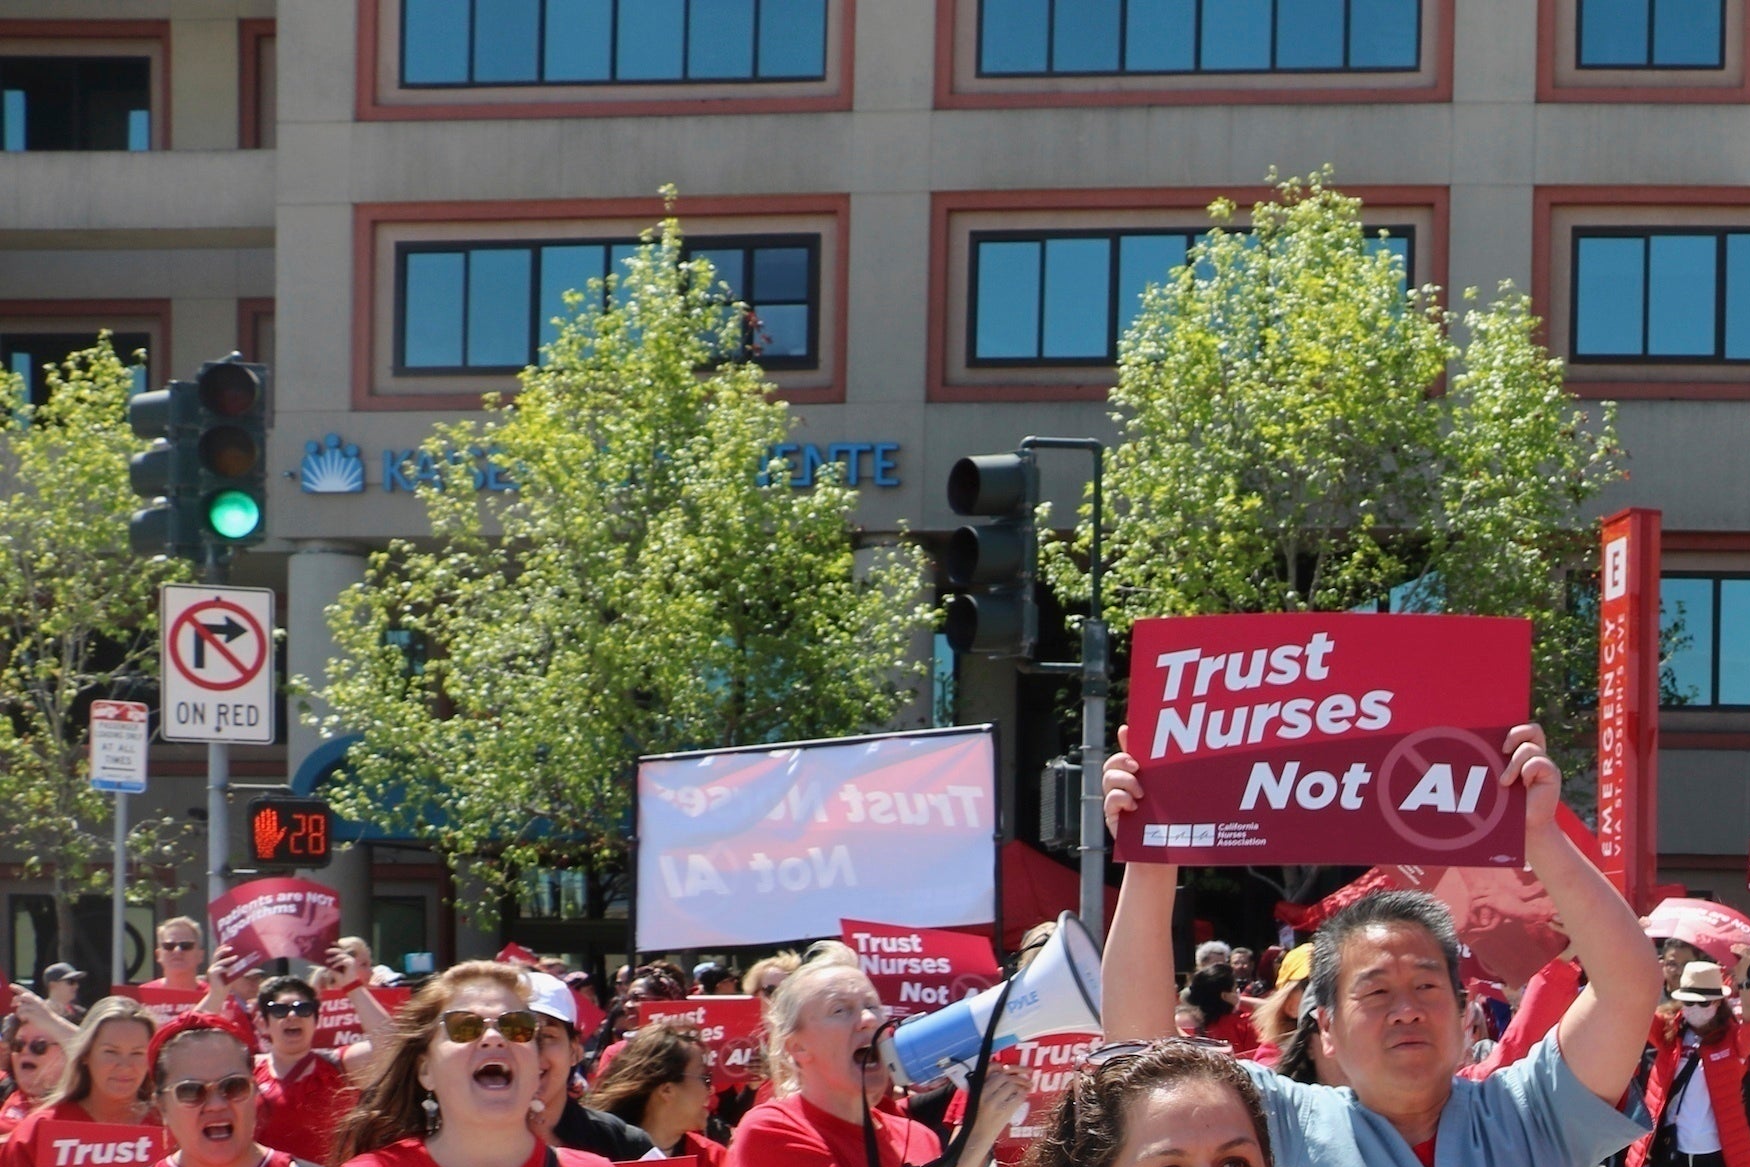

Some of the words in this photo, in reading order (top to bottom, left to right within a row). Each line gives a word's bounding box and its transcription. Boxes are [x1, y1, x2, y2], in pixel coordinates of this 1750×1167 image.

[1611, 551, 1620, 588] E
[1617, 613, 1626, 653] AVE
[1156, 632, 1335, 702] Trust
[176, 702, 206, 725] ON
[217, 703, 259, 727] RED
[1150, 690, 1395, 760] Nurses
[1615, 665, 1624, 768] JOSEPH'S
[1601, 619, 1616, 857] EMERGENCY
[1239, 761, 1372, 810] Not
[1398, 763, 1488, 814] AI
[289, 814, 325, 854] 28
[1217, 830, 1247, 838] Nurses
[1217, 838, 1267, 847] Association
[1218, 822, 1259, 831] California
[1614, 820, 1622, 856] VIA
[217, 895, 273, 932] Patients
[276, 892, 304, 903] are
[306, 892, 335, 907] NOT
[852, 932, 923, 953] Trust
[858, 954, 951, 976] Nurses
[899, 982, 949, 1005] Not
[649, 1007, 706, 1024] Trust
[725, 1048, 752, 1066] AI
[53, 1136, 152, 1166] Trust
